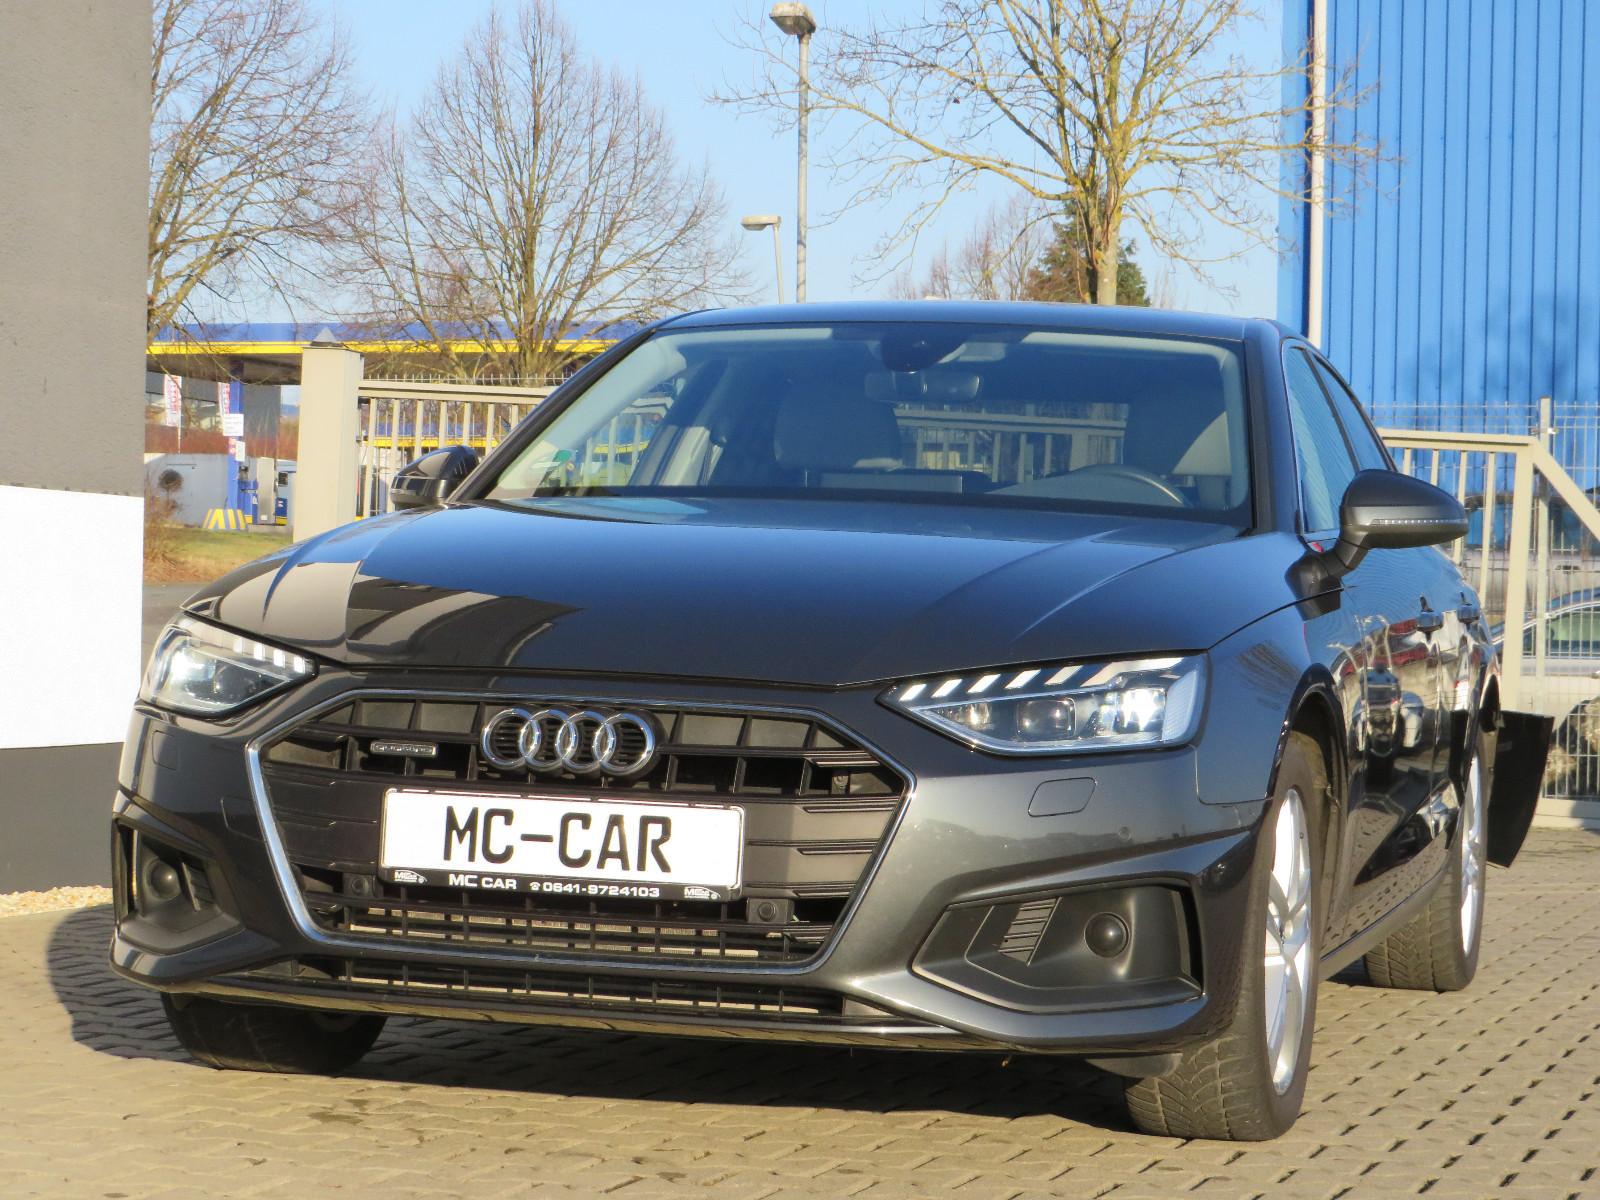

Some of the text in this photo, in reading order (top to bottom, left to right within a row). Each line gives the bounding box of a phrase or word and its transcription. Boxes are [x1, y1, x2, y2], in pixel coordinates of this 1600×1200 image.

[443, 805, 673, 873] MC-CAR
[448, 873, 478, 888] MC
[481, 877, 517, 890] CAR
